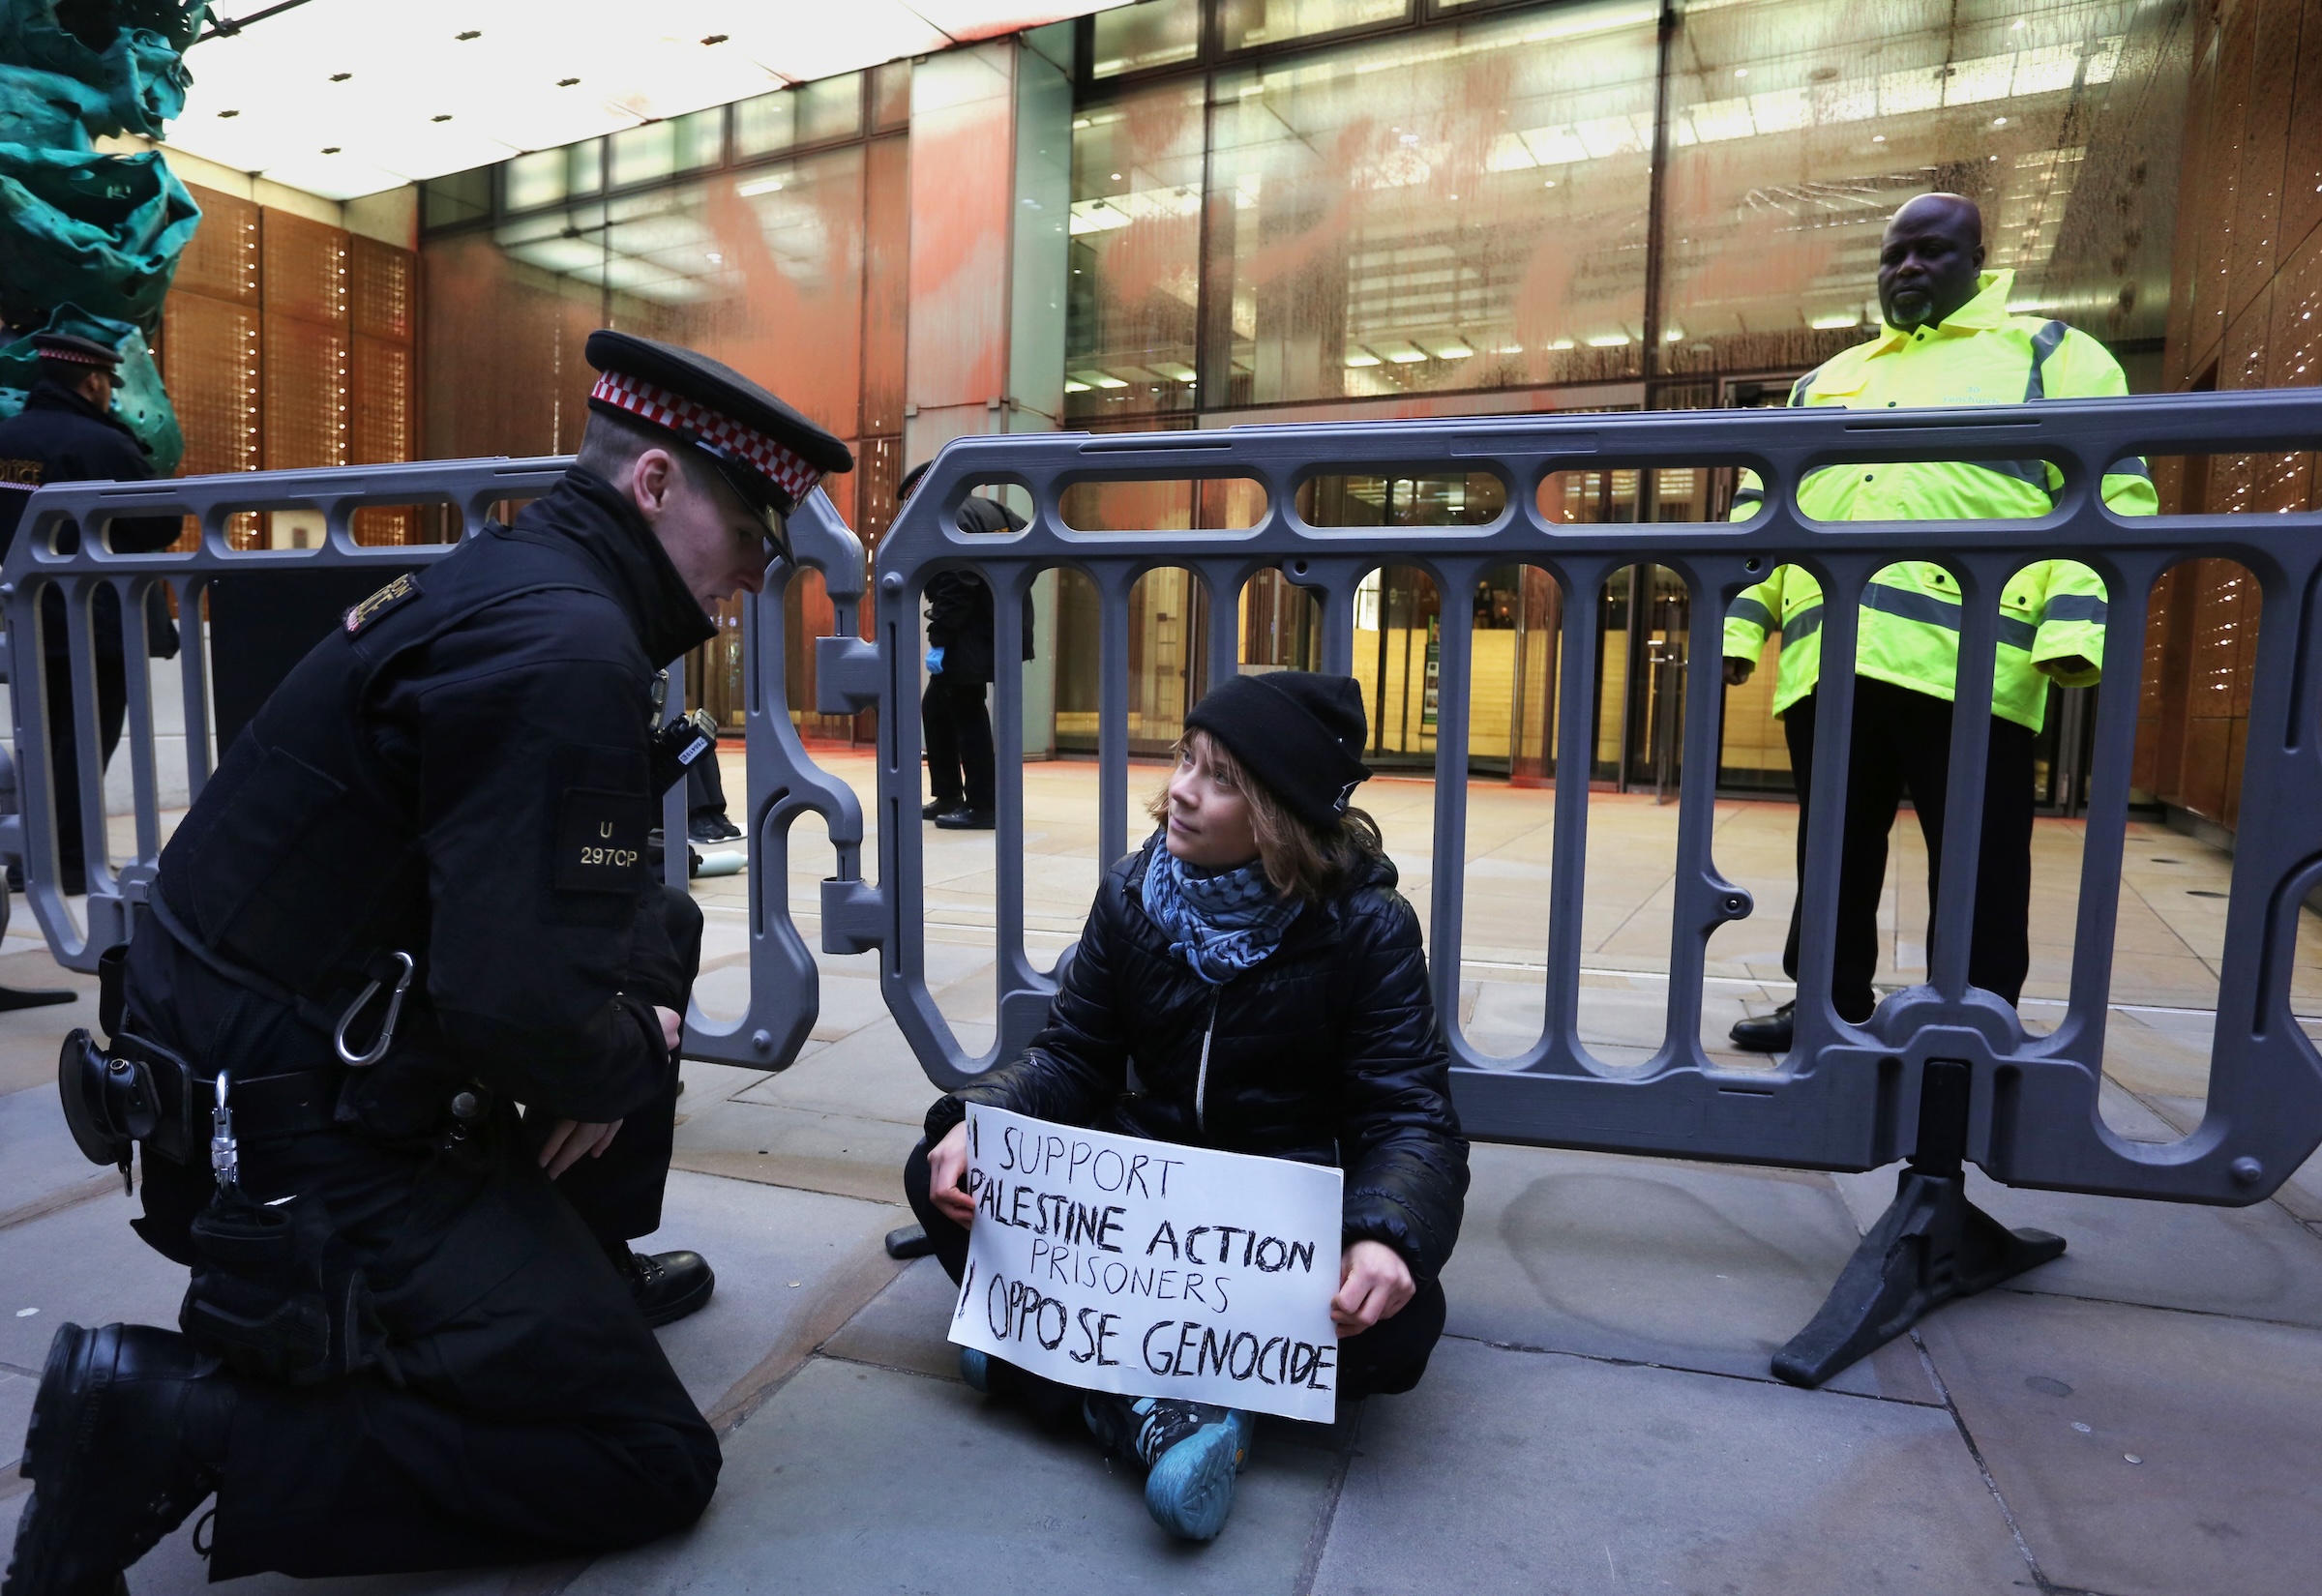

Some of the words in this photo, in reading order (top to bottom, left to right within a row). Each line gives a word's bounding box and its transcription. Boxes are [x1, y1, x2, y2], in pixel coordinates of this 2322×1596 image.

[580, 846, 638, 868] 297CP
[600, 821, 612, 839] U
[967, 1112, 979, 1159] I
[999, 1126, 1185, 1199] SUPPORT
[968, 1167, 1126, 1254] PALESTINE
[1146, 1220, 1316, 1274] ACTION
[1030, 1238, 1232, 1314] PRISONERS
[988, 1273, 1122, 1367] OPPOSE
[1143, 1320, 1337, 1391] GENOCIDE
